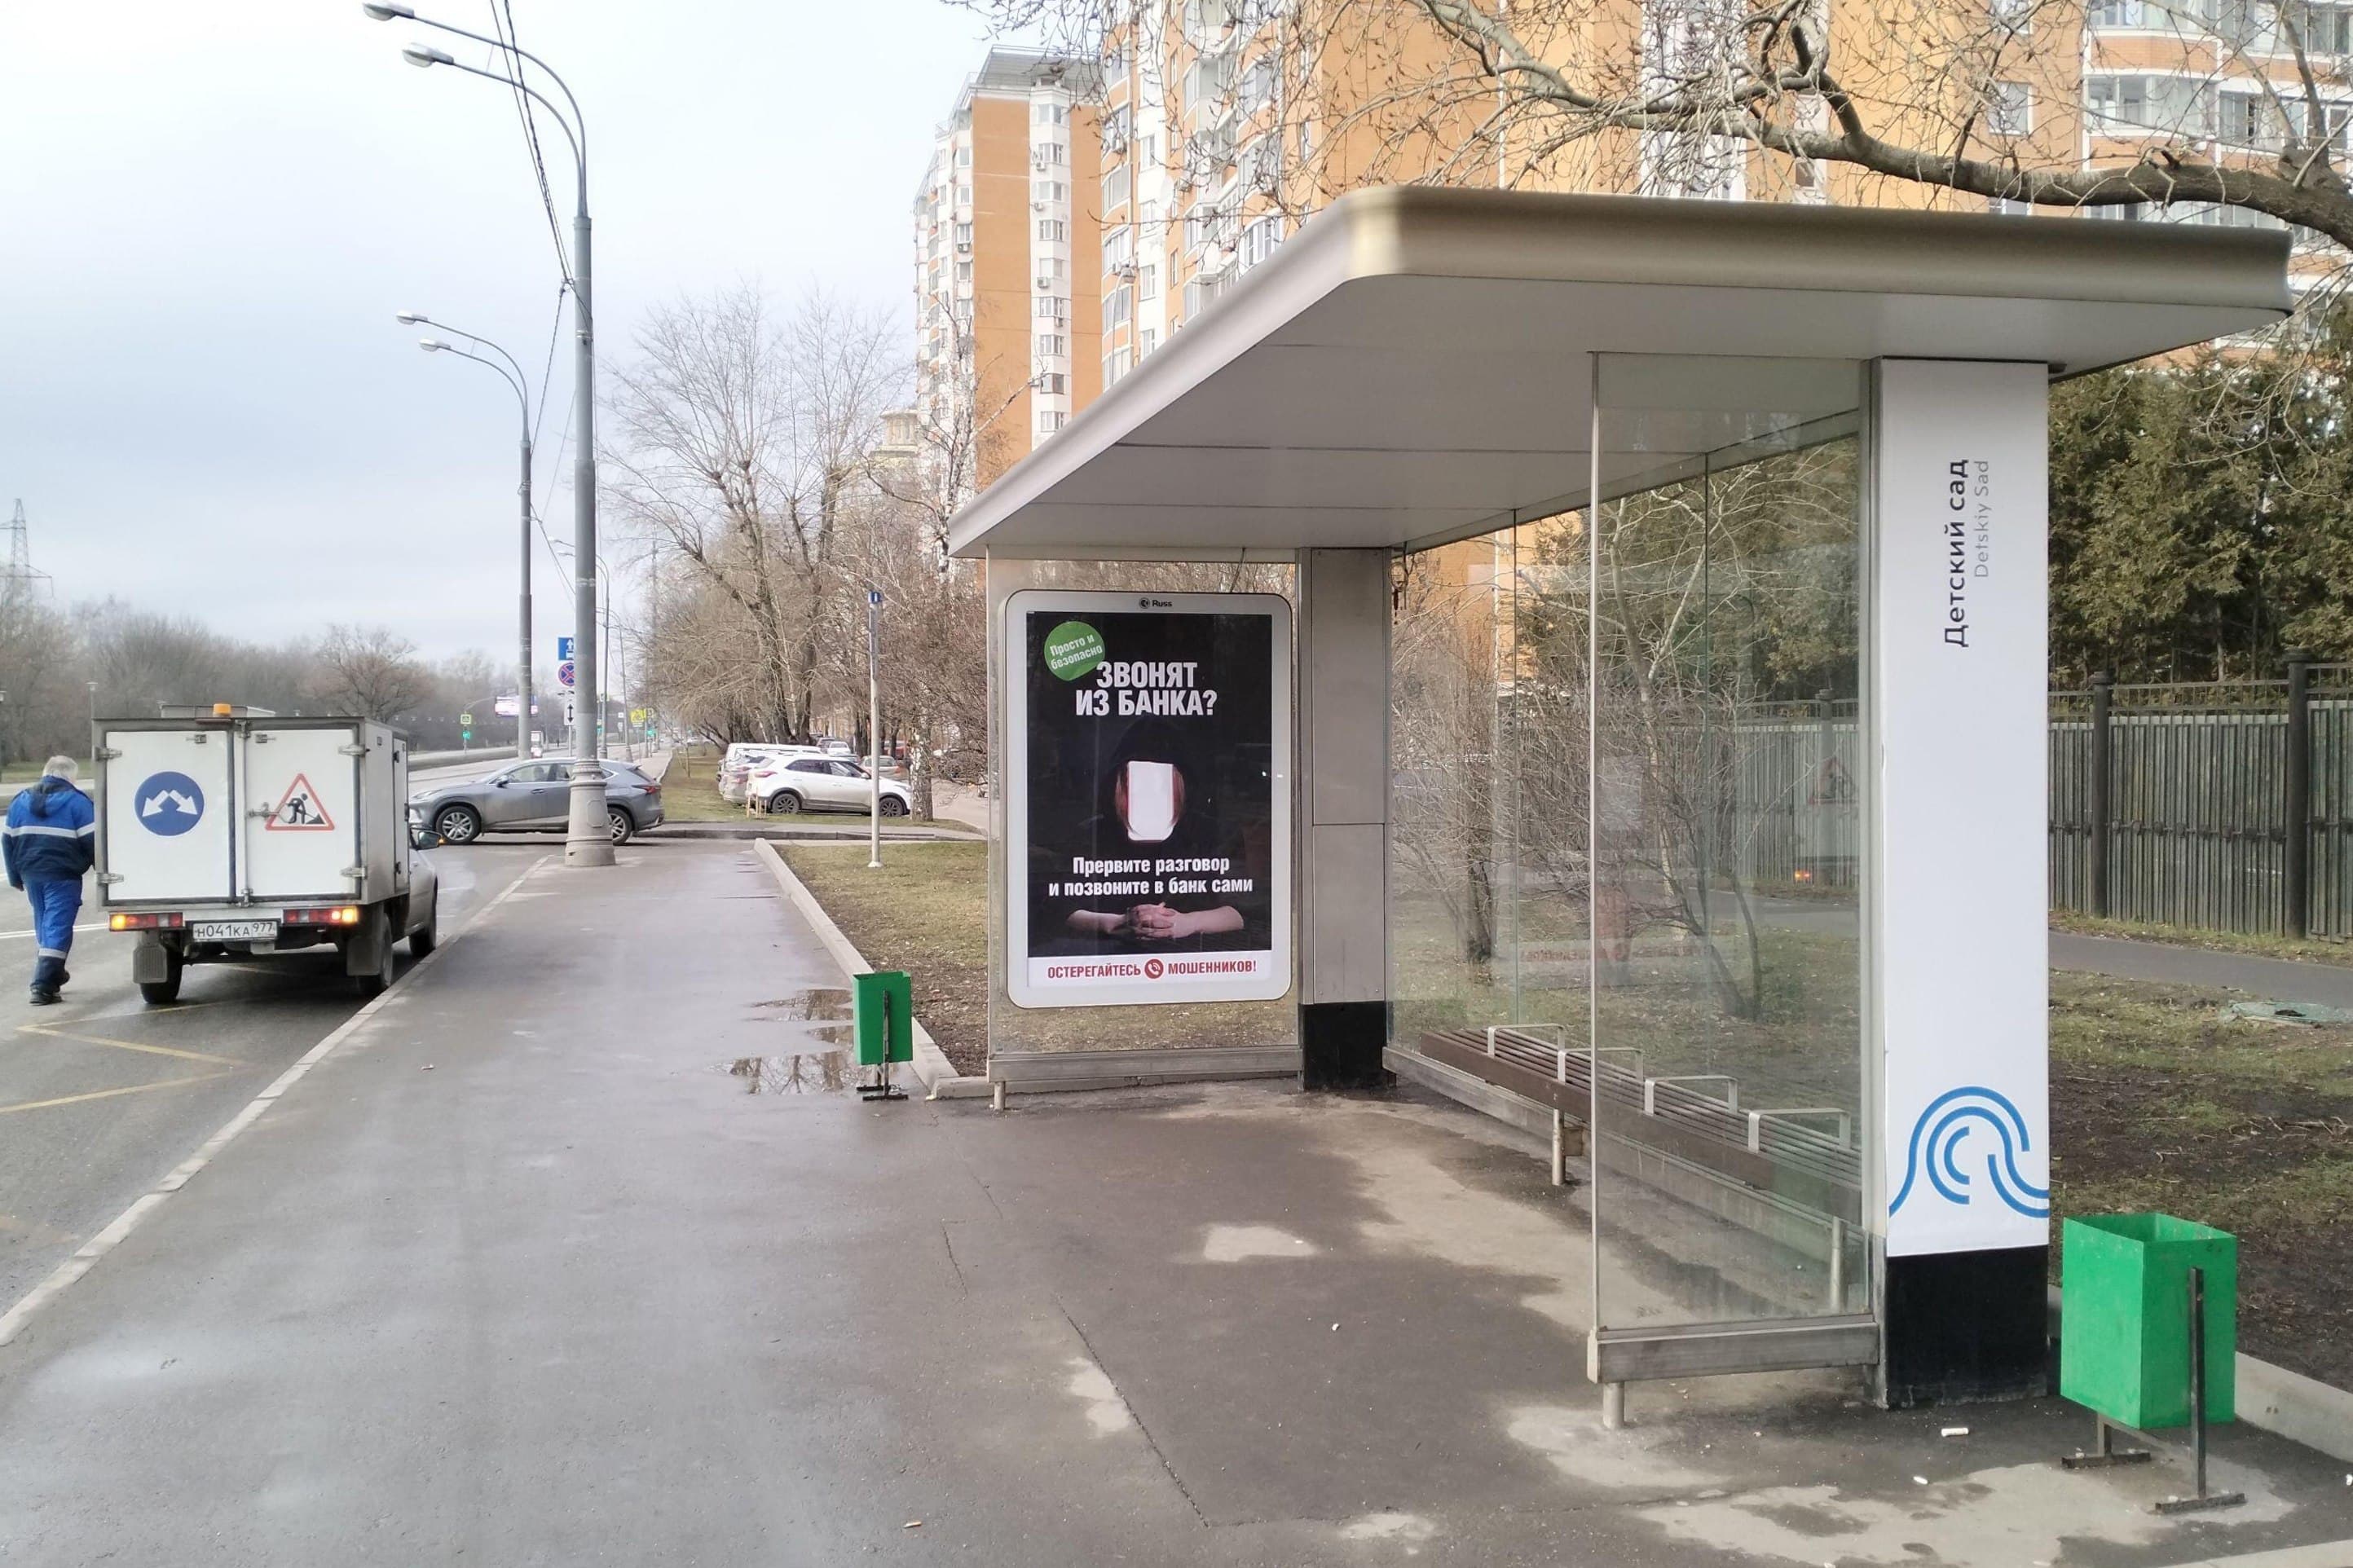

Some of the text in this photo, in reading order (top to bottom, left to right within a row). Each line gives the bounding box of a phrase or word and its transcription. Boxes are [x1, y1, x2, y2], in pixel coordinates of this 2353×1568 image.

[1974, 460, 1992, 577] Detskiy Sad
[1944, 459, 1969, 647] Детский сад
[1050, 634, 1095, 656] Просто и
[1051, 645, 1103, 670] безопасно
[1096, 661, 1197, 688] ЗВОНЯТ
[1076, 689, 1218, 716] ИЗ БАНКА?
[1073, 857, 1230, 878] Прервите разговор
[1049, 877, 1253, 896] и позвоните в банк сами
[1047, 960, 1257, 979] ОСТЕРЕГАЙТЕСЬ МОШЕННИКОВ!
